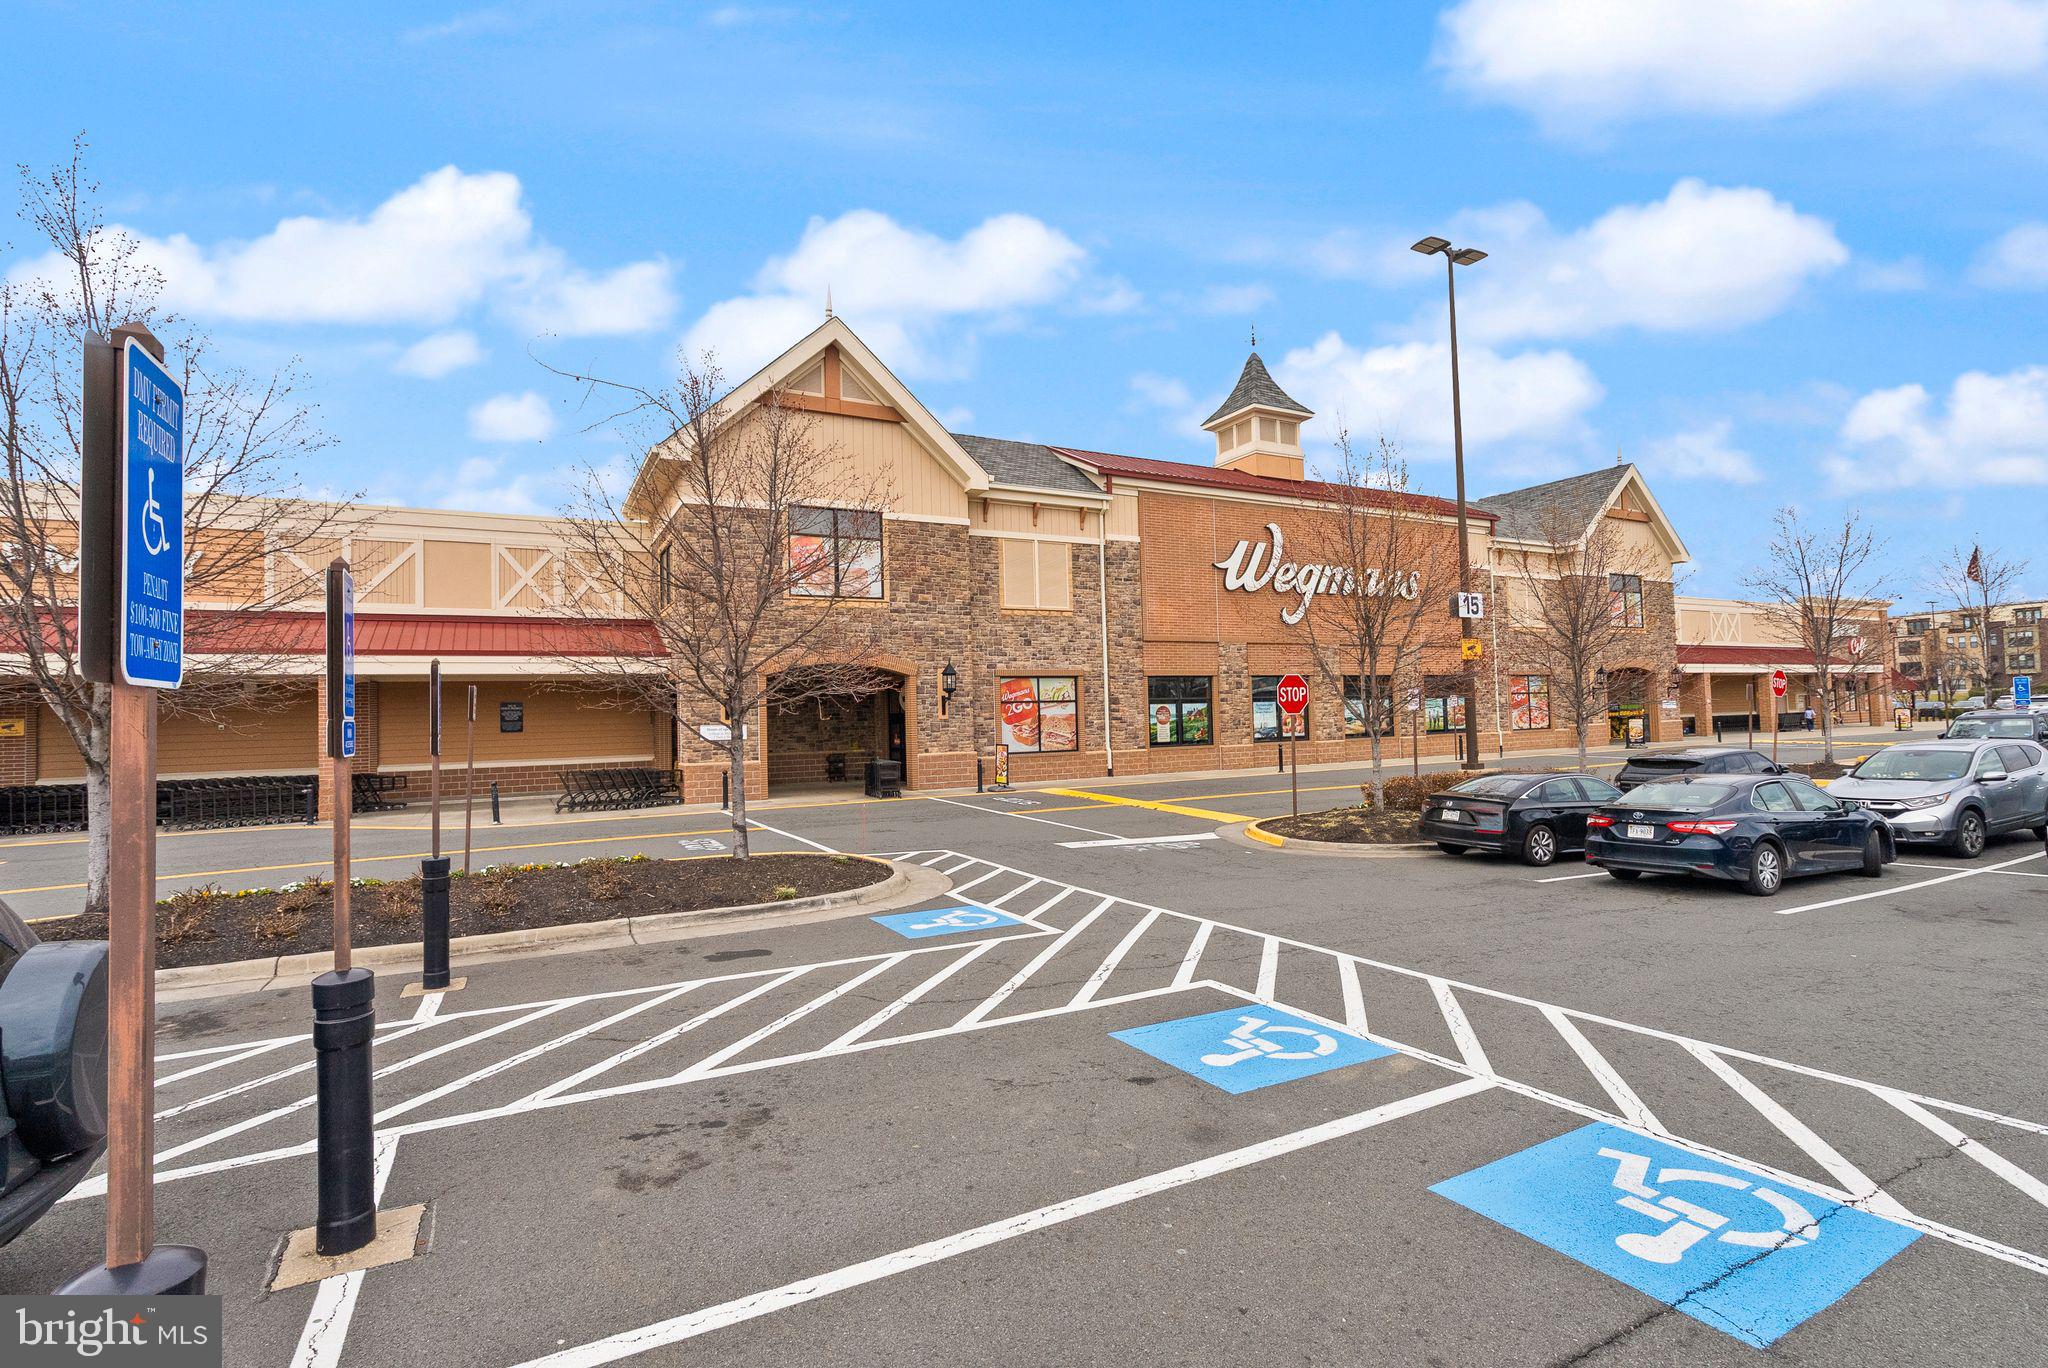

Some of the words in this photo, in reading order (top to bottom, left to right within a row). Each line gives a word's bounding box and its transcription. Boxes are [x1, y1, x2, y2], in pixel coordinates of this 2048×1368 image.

[133, 366, 151, 408] DMV
[152, 383, 179, 431] PERMIT
[137, 409, 176, 463] REQUIRED
[143, 571, 169, 602] PENALTY
[130, 600, 161, 630] $100-500
[161, 609, 179, 635] FINE
[1463, 596, 1480, 615] 15
[130, 633, 163, 661] TOW-AWAY
[163, 640, 179, 664] ZONE
[1001, 688, 1030, 702] Wegmans
[1279, 687, 1307, 702] STOP
[1772, 677, 1786, 690] STOP
[1005, 697, 1033, 717] 2GO
